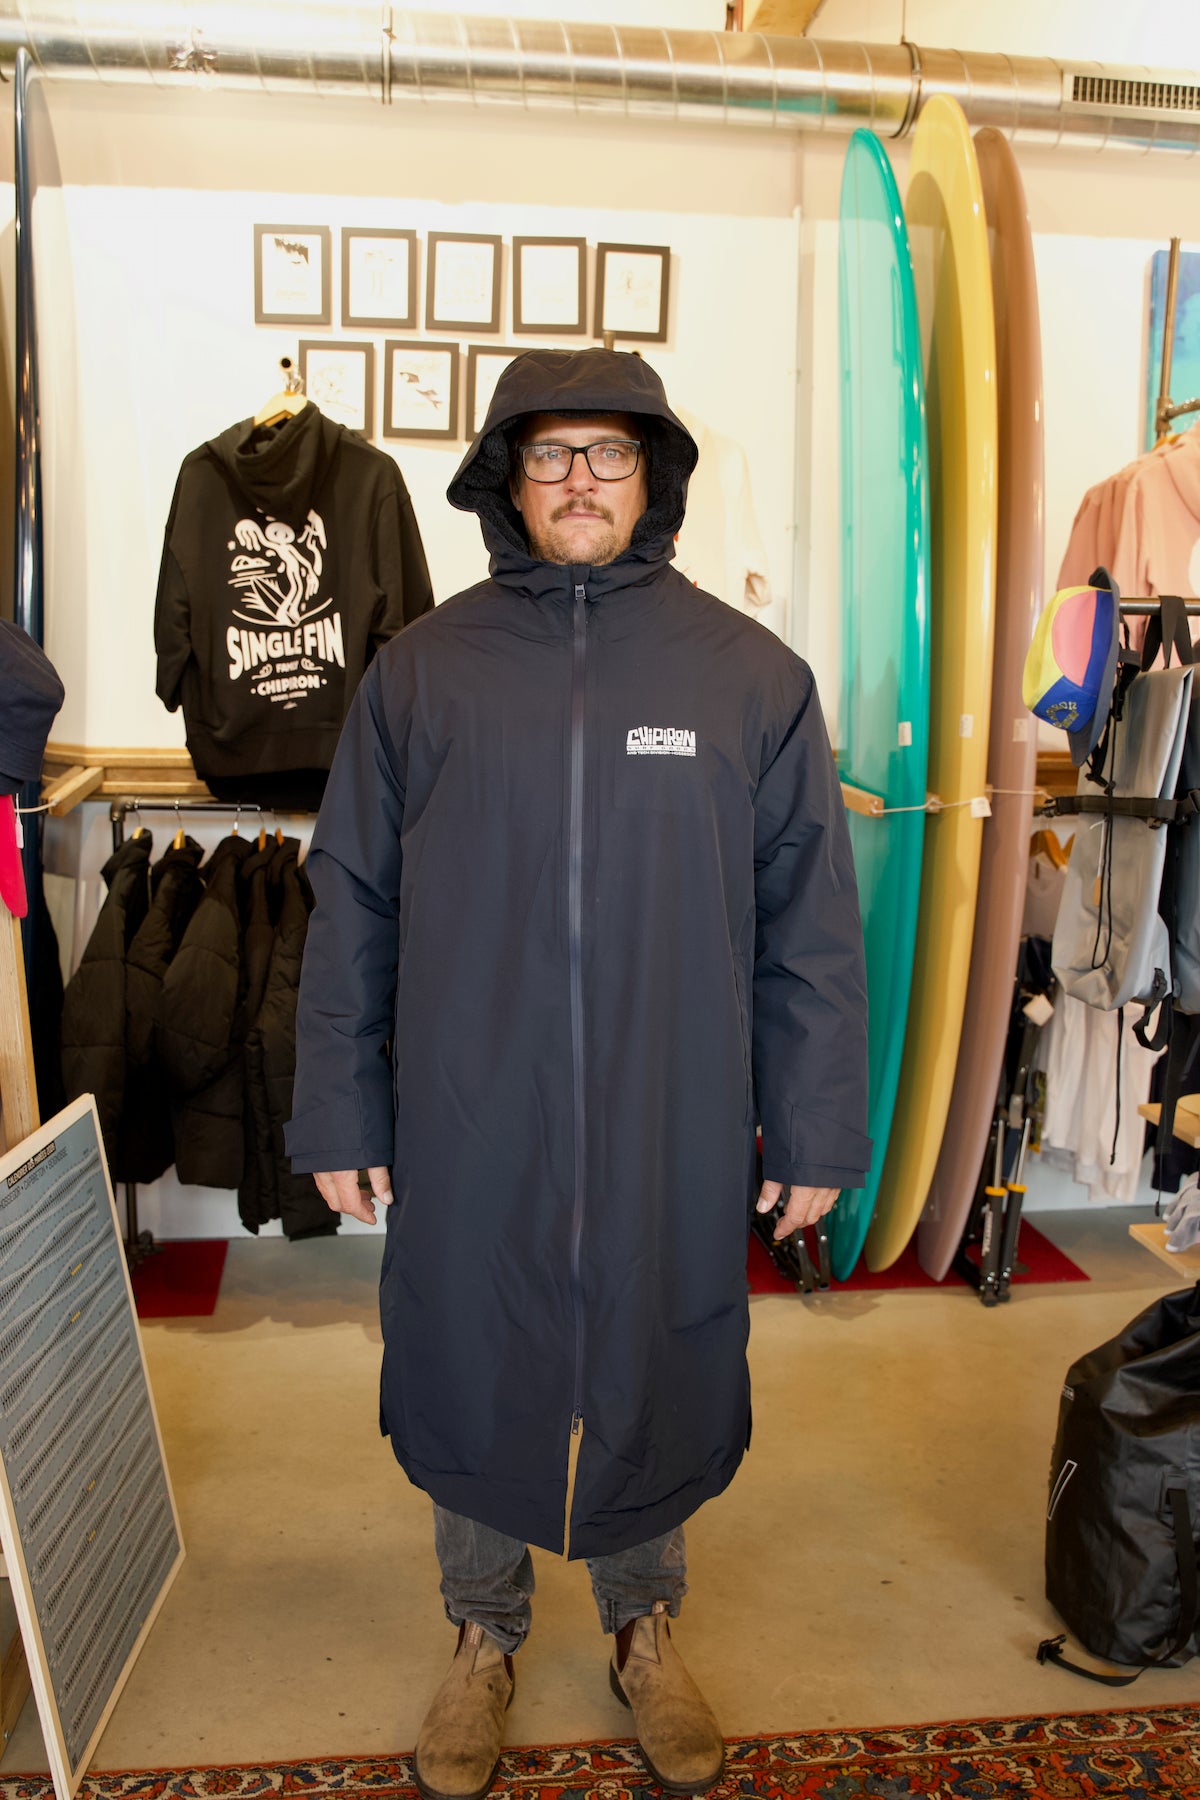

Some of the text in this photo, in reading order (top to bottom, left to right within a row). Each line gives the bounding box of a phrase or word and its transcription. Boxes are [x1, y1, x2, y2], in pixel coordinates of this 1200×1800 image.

[226, 612, 346, 680] SINGLE FIN
[626, 726, 696, 747] CHIPIRON
